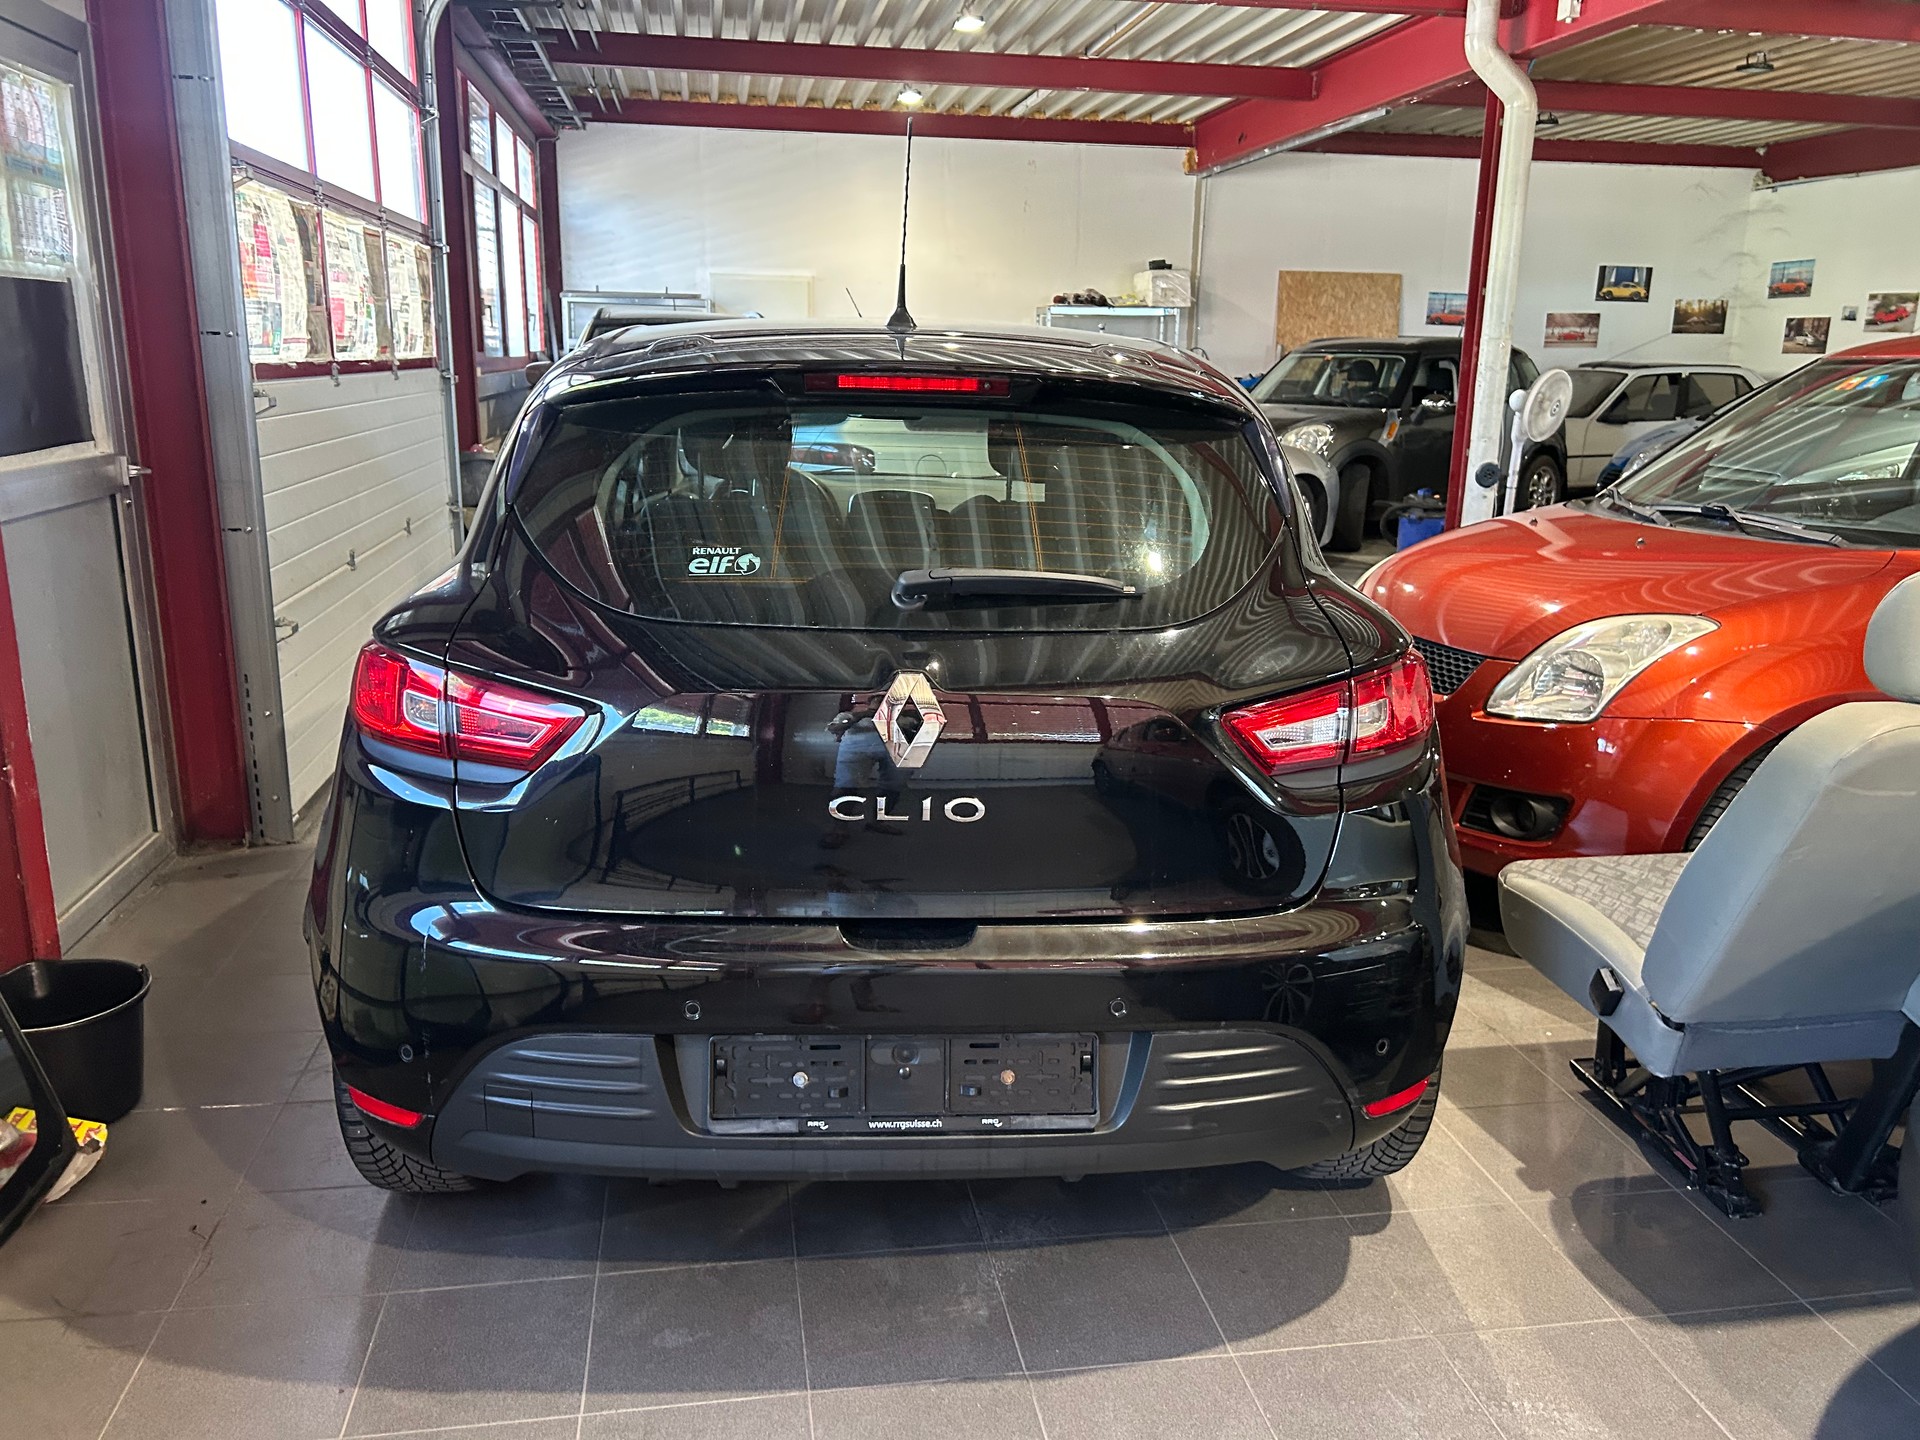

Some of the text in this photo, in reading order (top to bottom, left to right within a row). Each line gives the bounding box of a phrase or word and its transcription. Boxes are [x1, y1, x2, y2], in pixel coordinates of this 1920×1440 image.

[692, 546, 742, 555] RENAULT
[688, 555, 735, 574] elf
[828, 795, 986, 822] CLIO
[868, 1118, 943, 1130] www.rrgsuisse.ch
